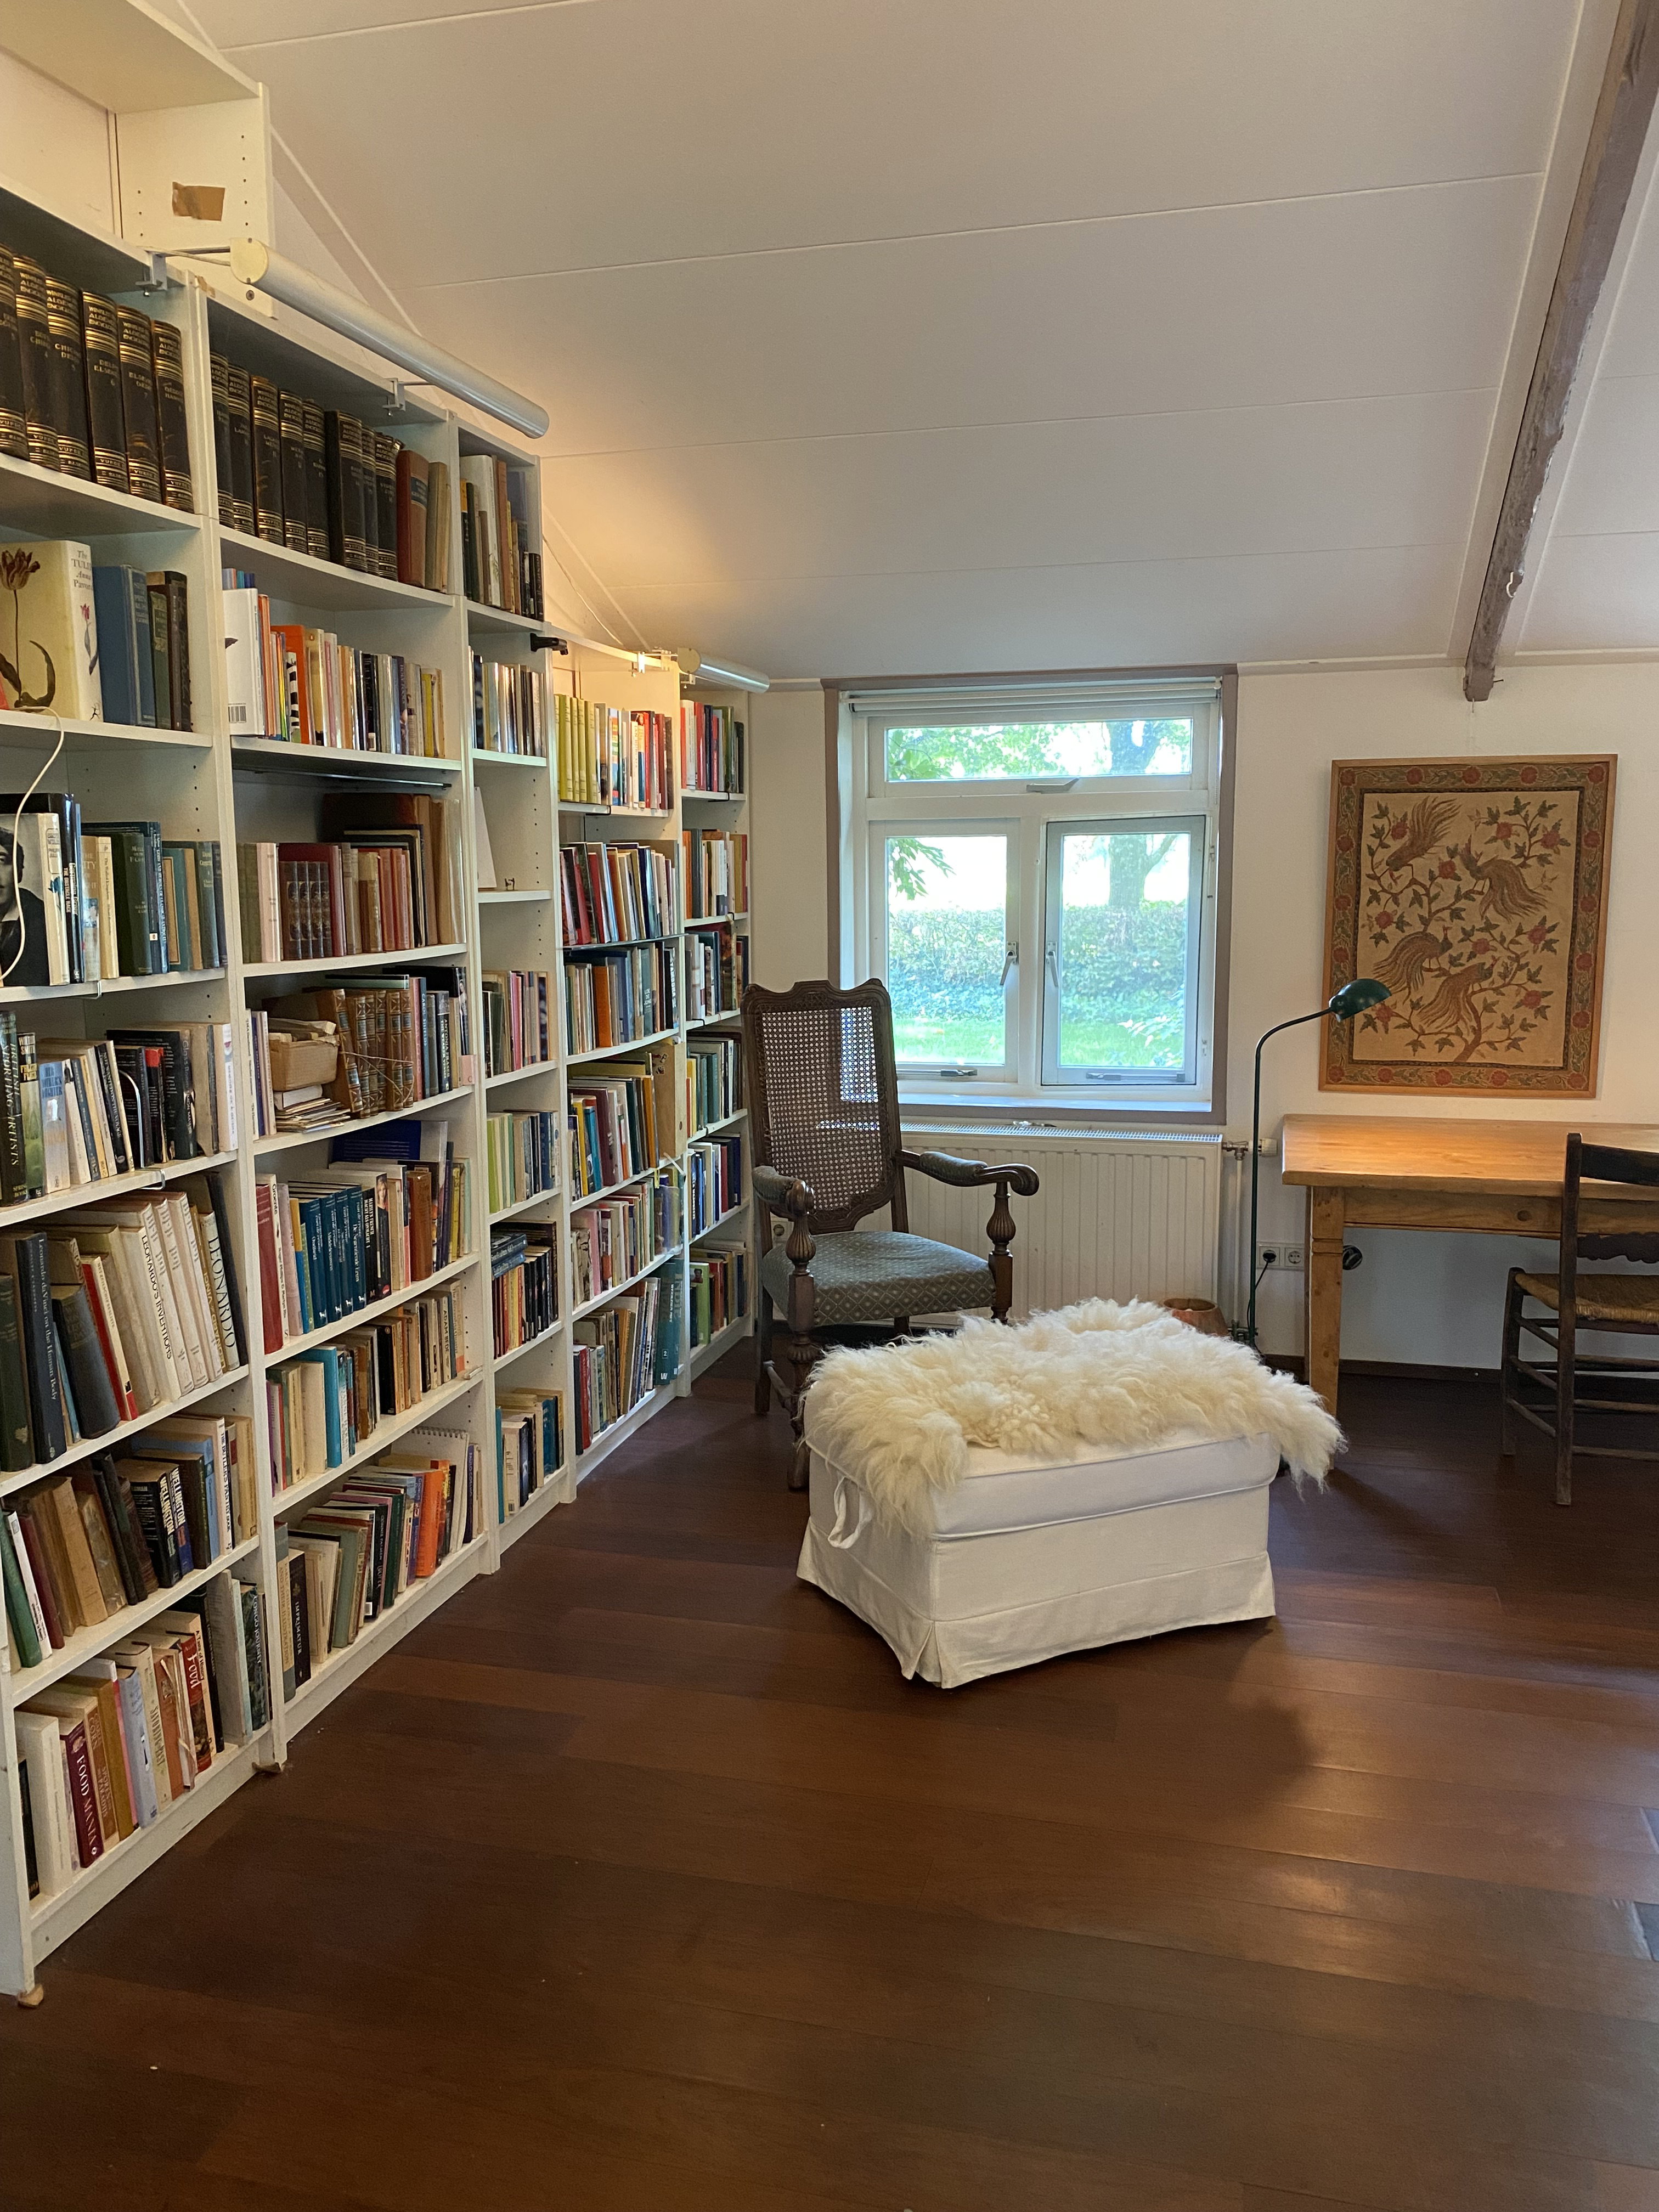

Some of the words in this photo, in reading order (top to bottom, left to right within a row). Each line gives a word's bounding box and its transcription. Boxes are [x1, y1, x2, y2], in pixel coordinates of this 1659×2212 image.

[2, 1045, 14, 1108] SPORTING
[10, 1043, 20, 1096] BRITISH
[7, 1113, 19, 1165] ARTISTS
[38, 1238, 47, 1280] Leonardo
[141, 1234, 161, 1300] LEONARDO'S
[155, 1300, 173, 1359] INVENTIONS
[204, 1272, 213, 1305] VINCI
[208, 1237, 235, 1348] LEONARDO
[44, 1316, 50, 1328] on
[47, 1344, 55, 1377] Human
[660, 1372, 668, 1380] W
[49, 1377, 58, 1400] Body
[160, 1476, 175, 1536] WELLINGTON
[171, 1468, 186, 1526] WELLINGTON
[254, 1628, 262, 1664] JOURNEY
[187, 1652, 202, 1689] Food
[88, 1717, 98, 1750] CORN
[76, 1754, 90, 1796] FOOD
[83, 1797, 97, 1846] MANIA
